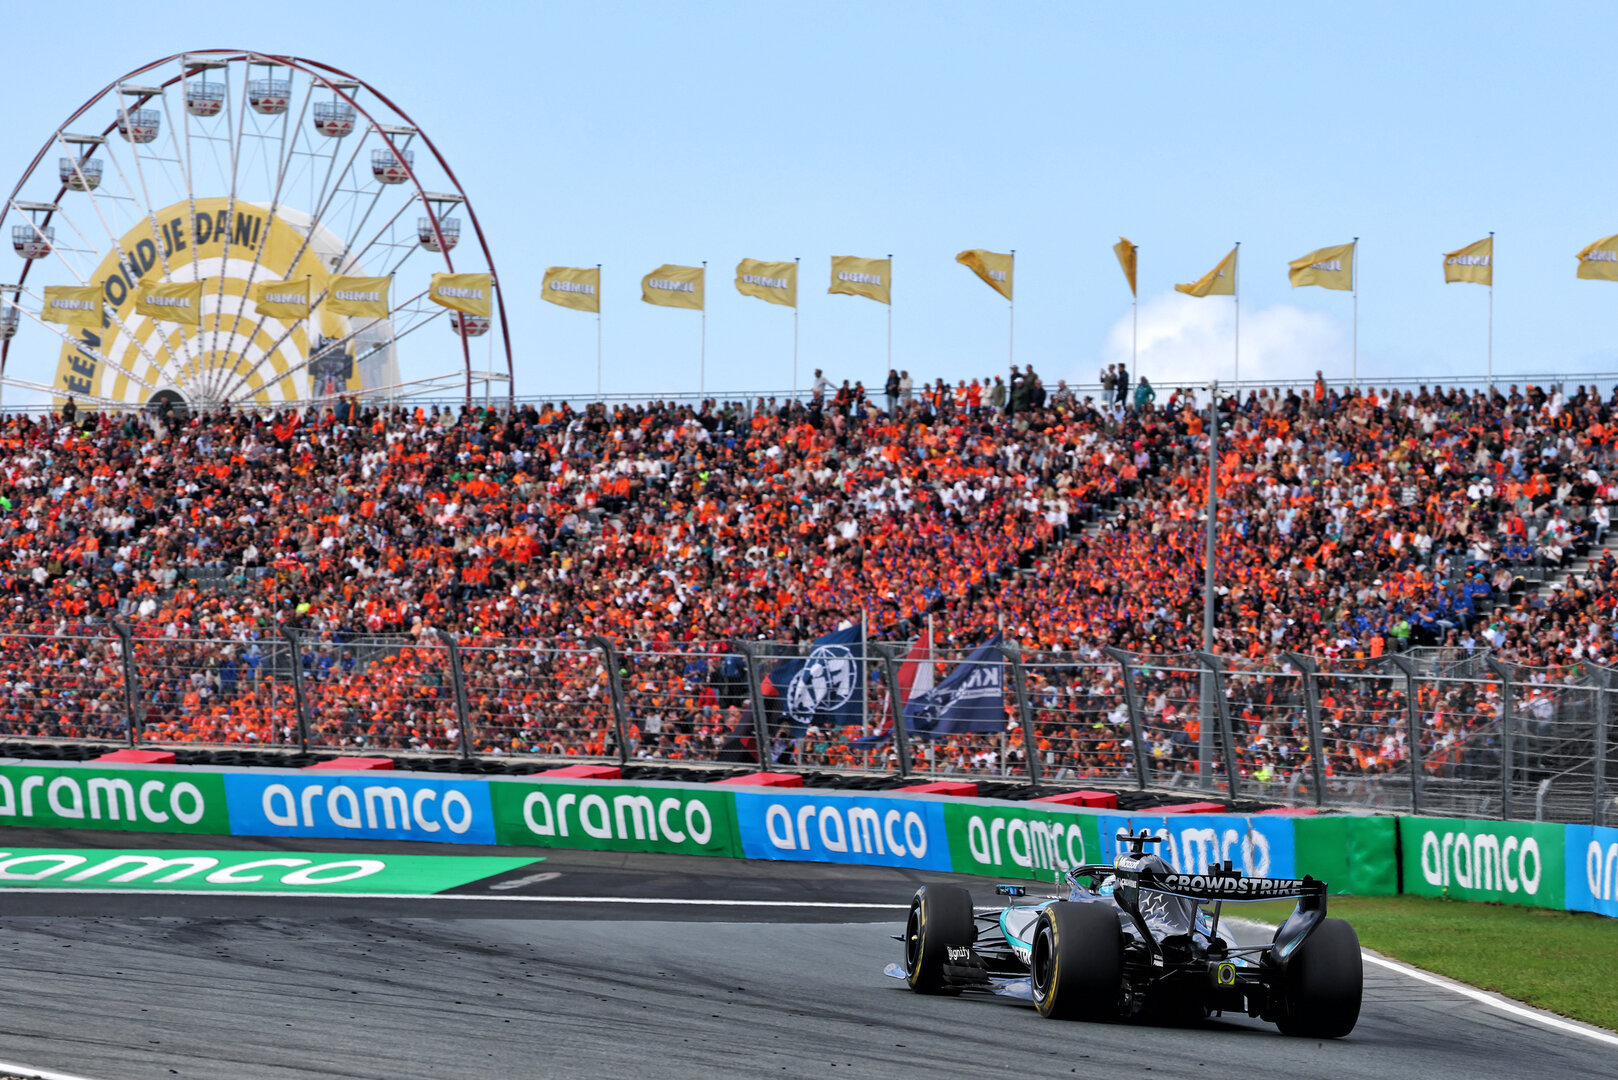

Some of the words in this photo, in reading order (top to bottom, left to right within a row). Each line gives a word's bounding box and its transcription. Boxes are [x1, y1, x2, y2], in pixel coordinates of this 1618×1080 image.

[161, 217, 187, 258] JE
[195, 209, 262, 251] DAN!
[263, 784, 473, 833] aramco
[523, 791, 713, 845] aramco
[766, 803, 928, 859] aramco
[0, 852, 386, 887] amco
[968, 815, 1086, 873] aramco
[1422, 831, 1542, 895] aramco
[1164, 874, 1304, 896] CROWDSTRIKE
